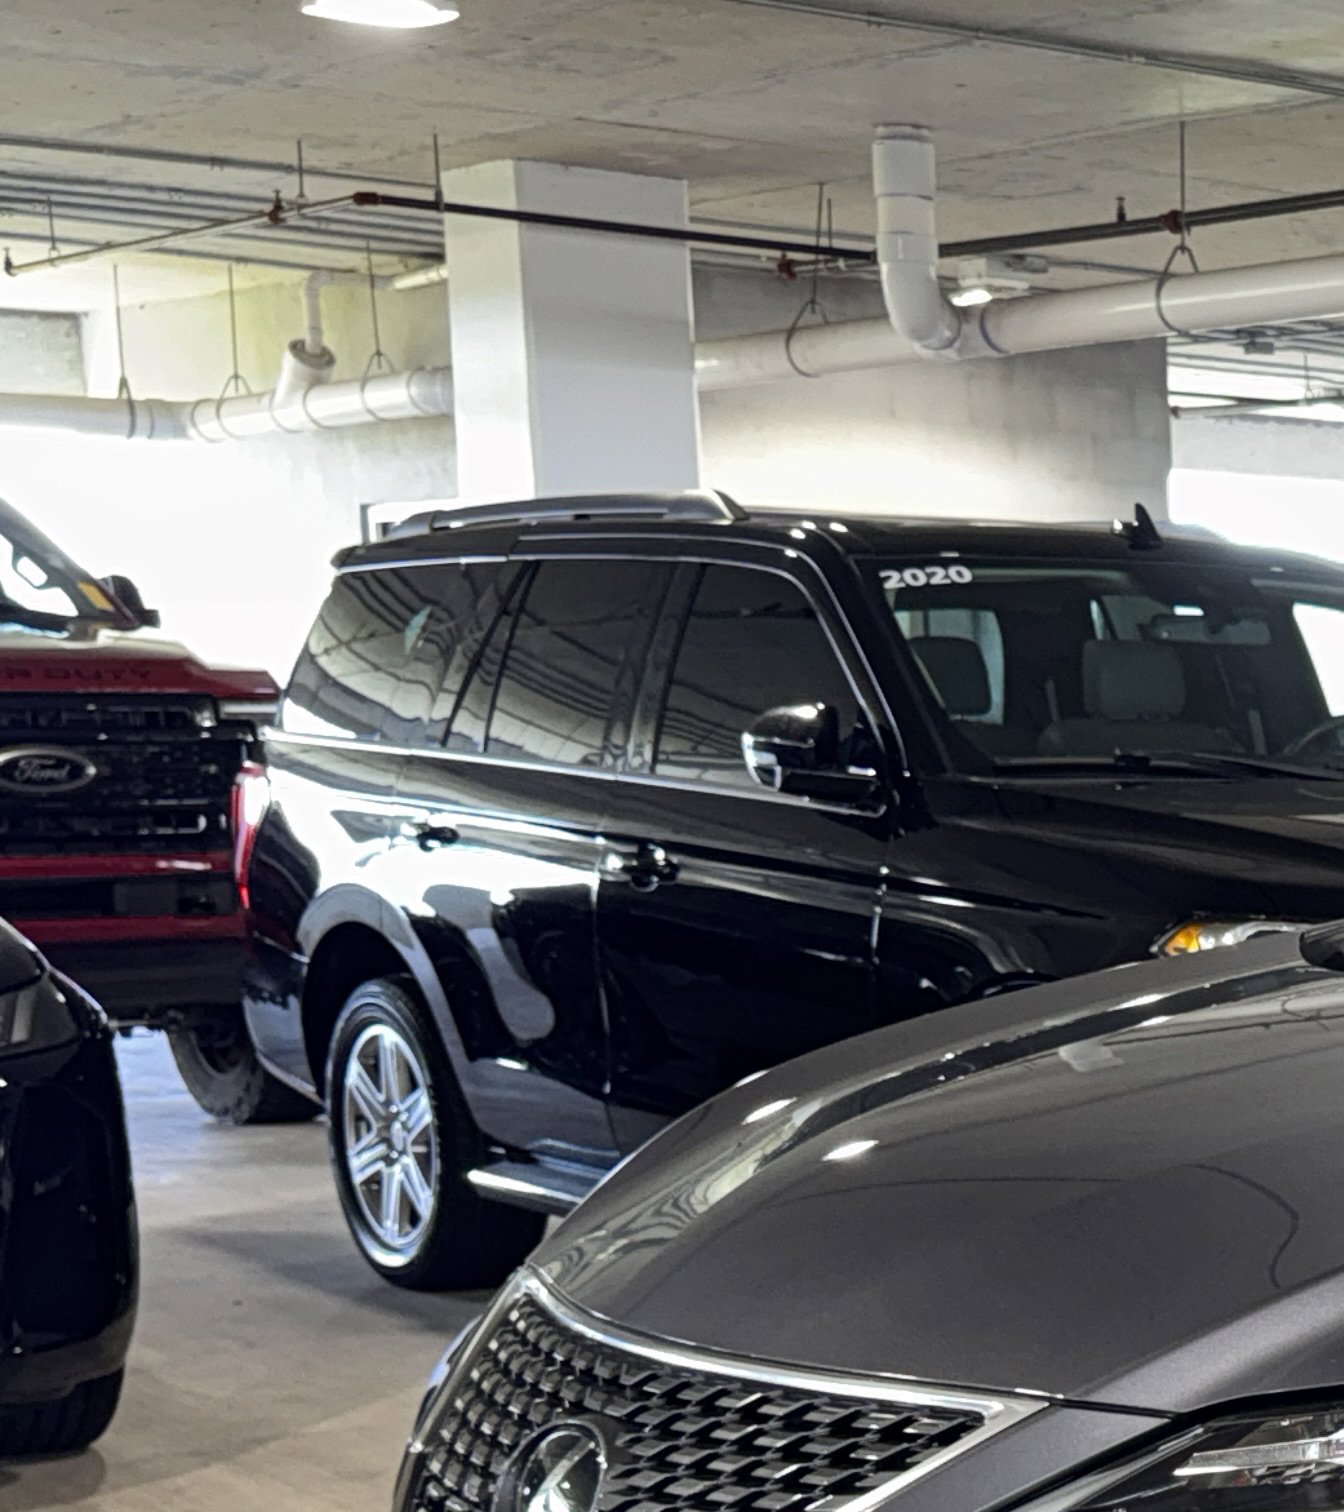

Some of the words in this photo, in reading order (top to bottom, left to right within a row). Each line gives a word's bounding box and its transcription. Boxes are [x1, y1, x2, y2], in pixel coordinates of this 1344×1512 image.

[879, 565, 973, 589] 2020
[44, 667, 152, 681] DUTY
[14, 756, 71, 782] Ford
